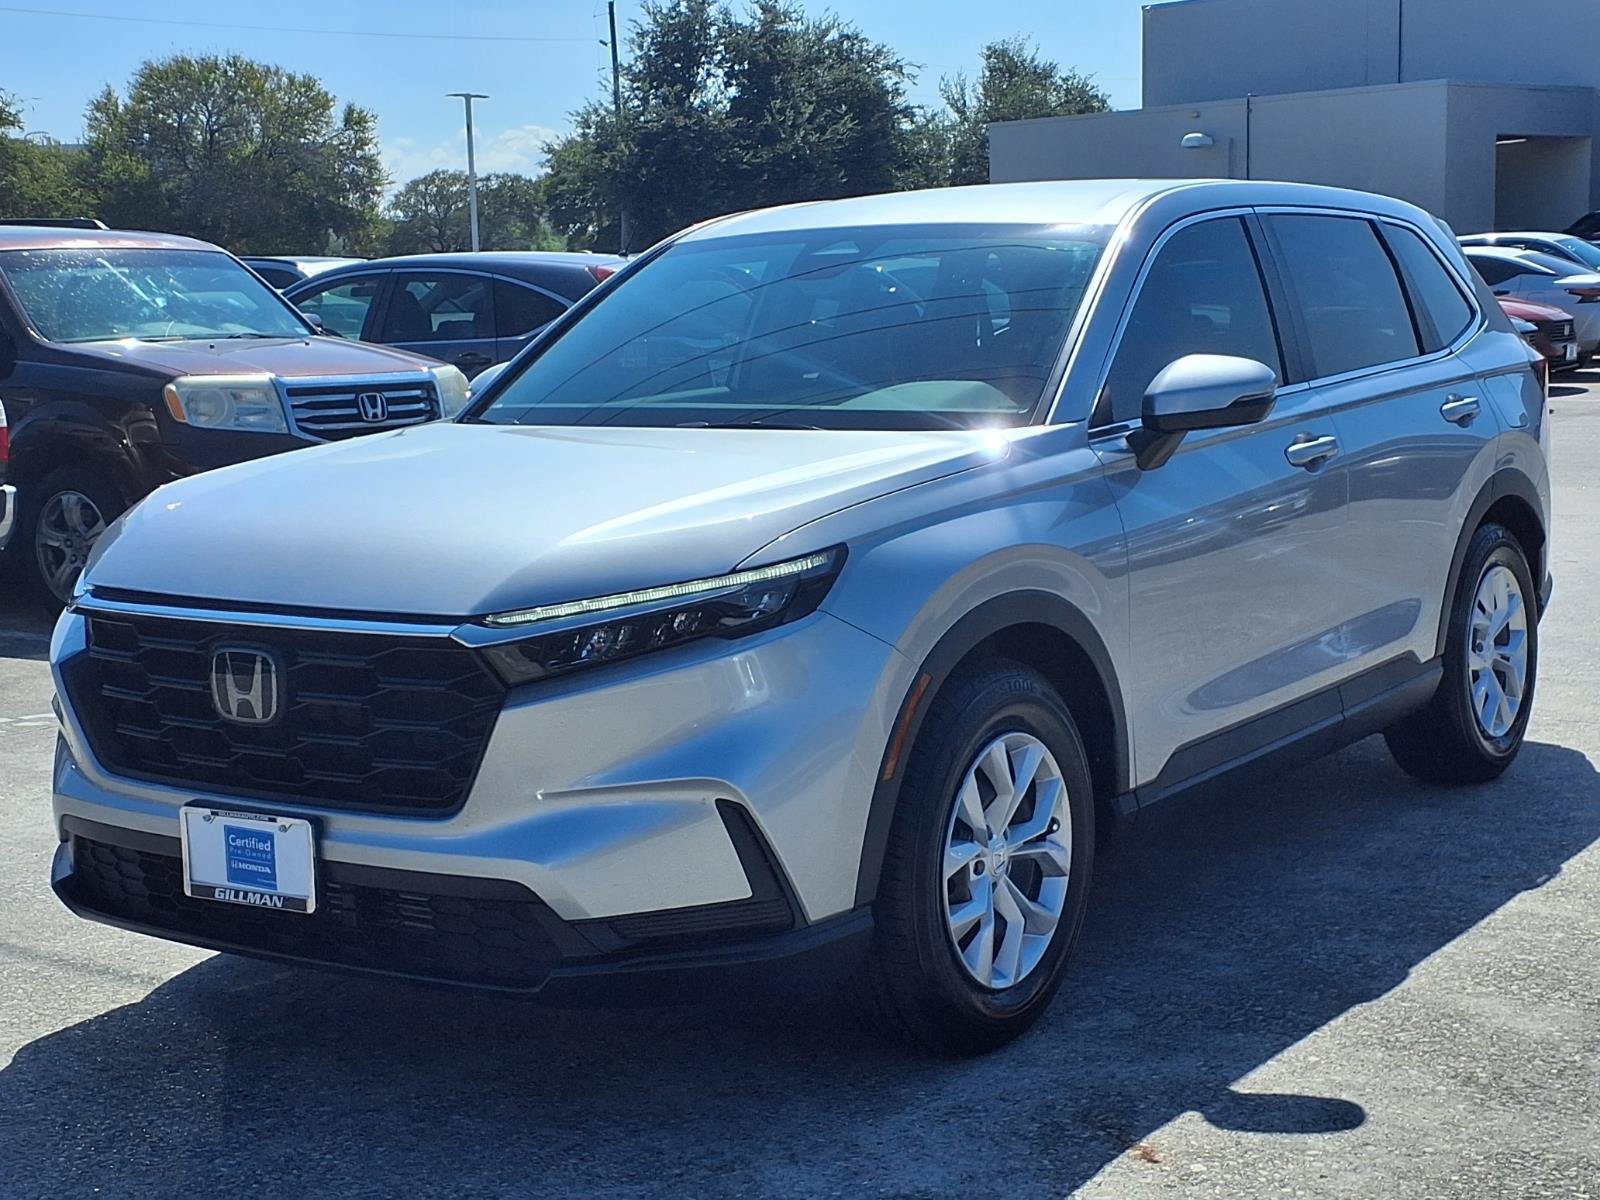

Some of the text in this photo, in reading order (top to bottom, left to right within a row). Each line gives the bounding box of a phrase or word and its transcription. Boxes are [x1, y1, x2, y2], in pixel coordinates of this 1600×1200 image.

[228, 834, 271, 851] Certified
[238, 861, 272, 874] HONDA
[214, 887, 284, 908] GILLMAN
